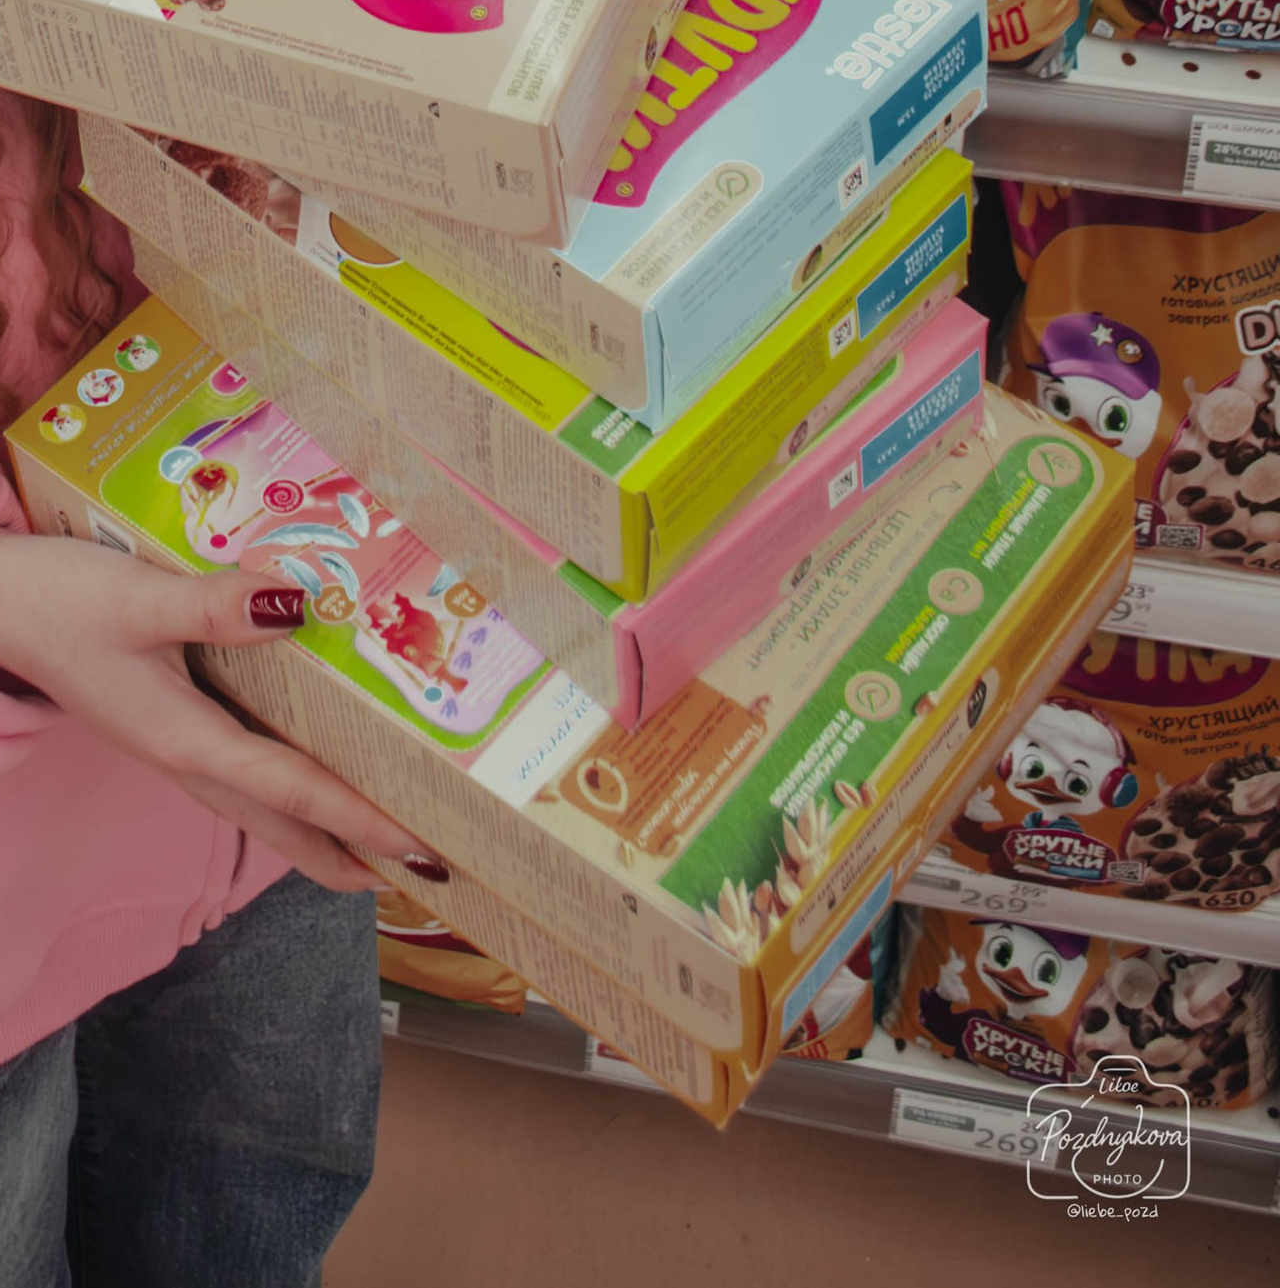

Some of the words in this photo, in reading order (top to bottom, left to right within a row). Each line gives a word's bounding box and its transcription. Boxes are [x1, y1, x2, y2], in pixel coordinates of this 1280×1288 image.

[504, 1, 561, 100] КОНСЕРВАНТОВ
[520, 19, 572, 104] КРАСИТЕЛЕЙ
[1166, 312, 1231, 329] завтрак
[981, 474, 1036, 544] ИНГРЕДИЕНТ
[1004, 480, 1051, 536] ЦЕЛЬНЫЕ
[839, 505, 913, 588] ЦЕЛЬНЫЕ
[978, 528, 1016, 572] ЗЛАКИ
[740, 574, 828, 675] ингредиент
[793, 581, 853, 646] ЗЛАКИ
[881, 600, 937, 669] КАЛЬЦИЕМ
[1149, 695, 1279, 732] ХРУСТЯЩИЙ
[764, 716, 843, 810] КОНСЕРВАНТОВ
[779, 742, 846, 820] КРАСИТЕЛЕЙ
[1016, 831, 1107, 859] ХРУТЫЕ
[1016, 844, 1105, 870] УРОКИ
[959, 888, 1030, 914] 269
[1204, 890, 1256, 908] 650
[972, 1020, 1065, 1066] ХРУТЫЕ
[972, 1036, 1065, 1078] УРОКИ
[974, 1127, 1039, 1156] 269
